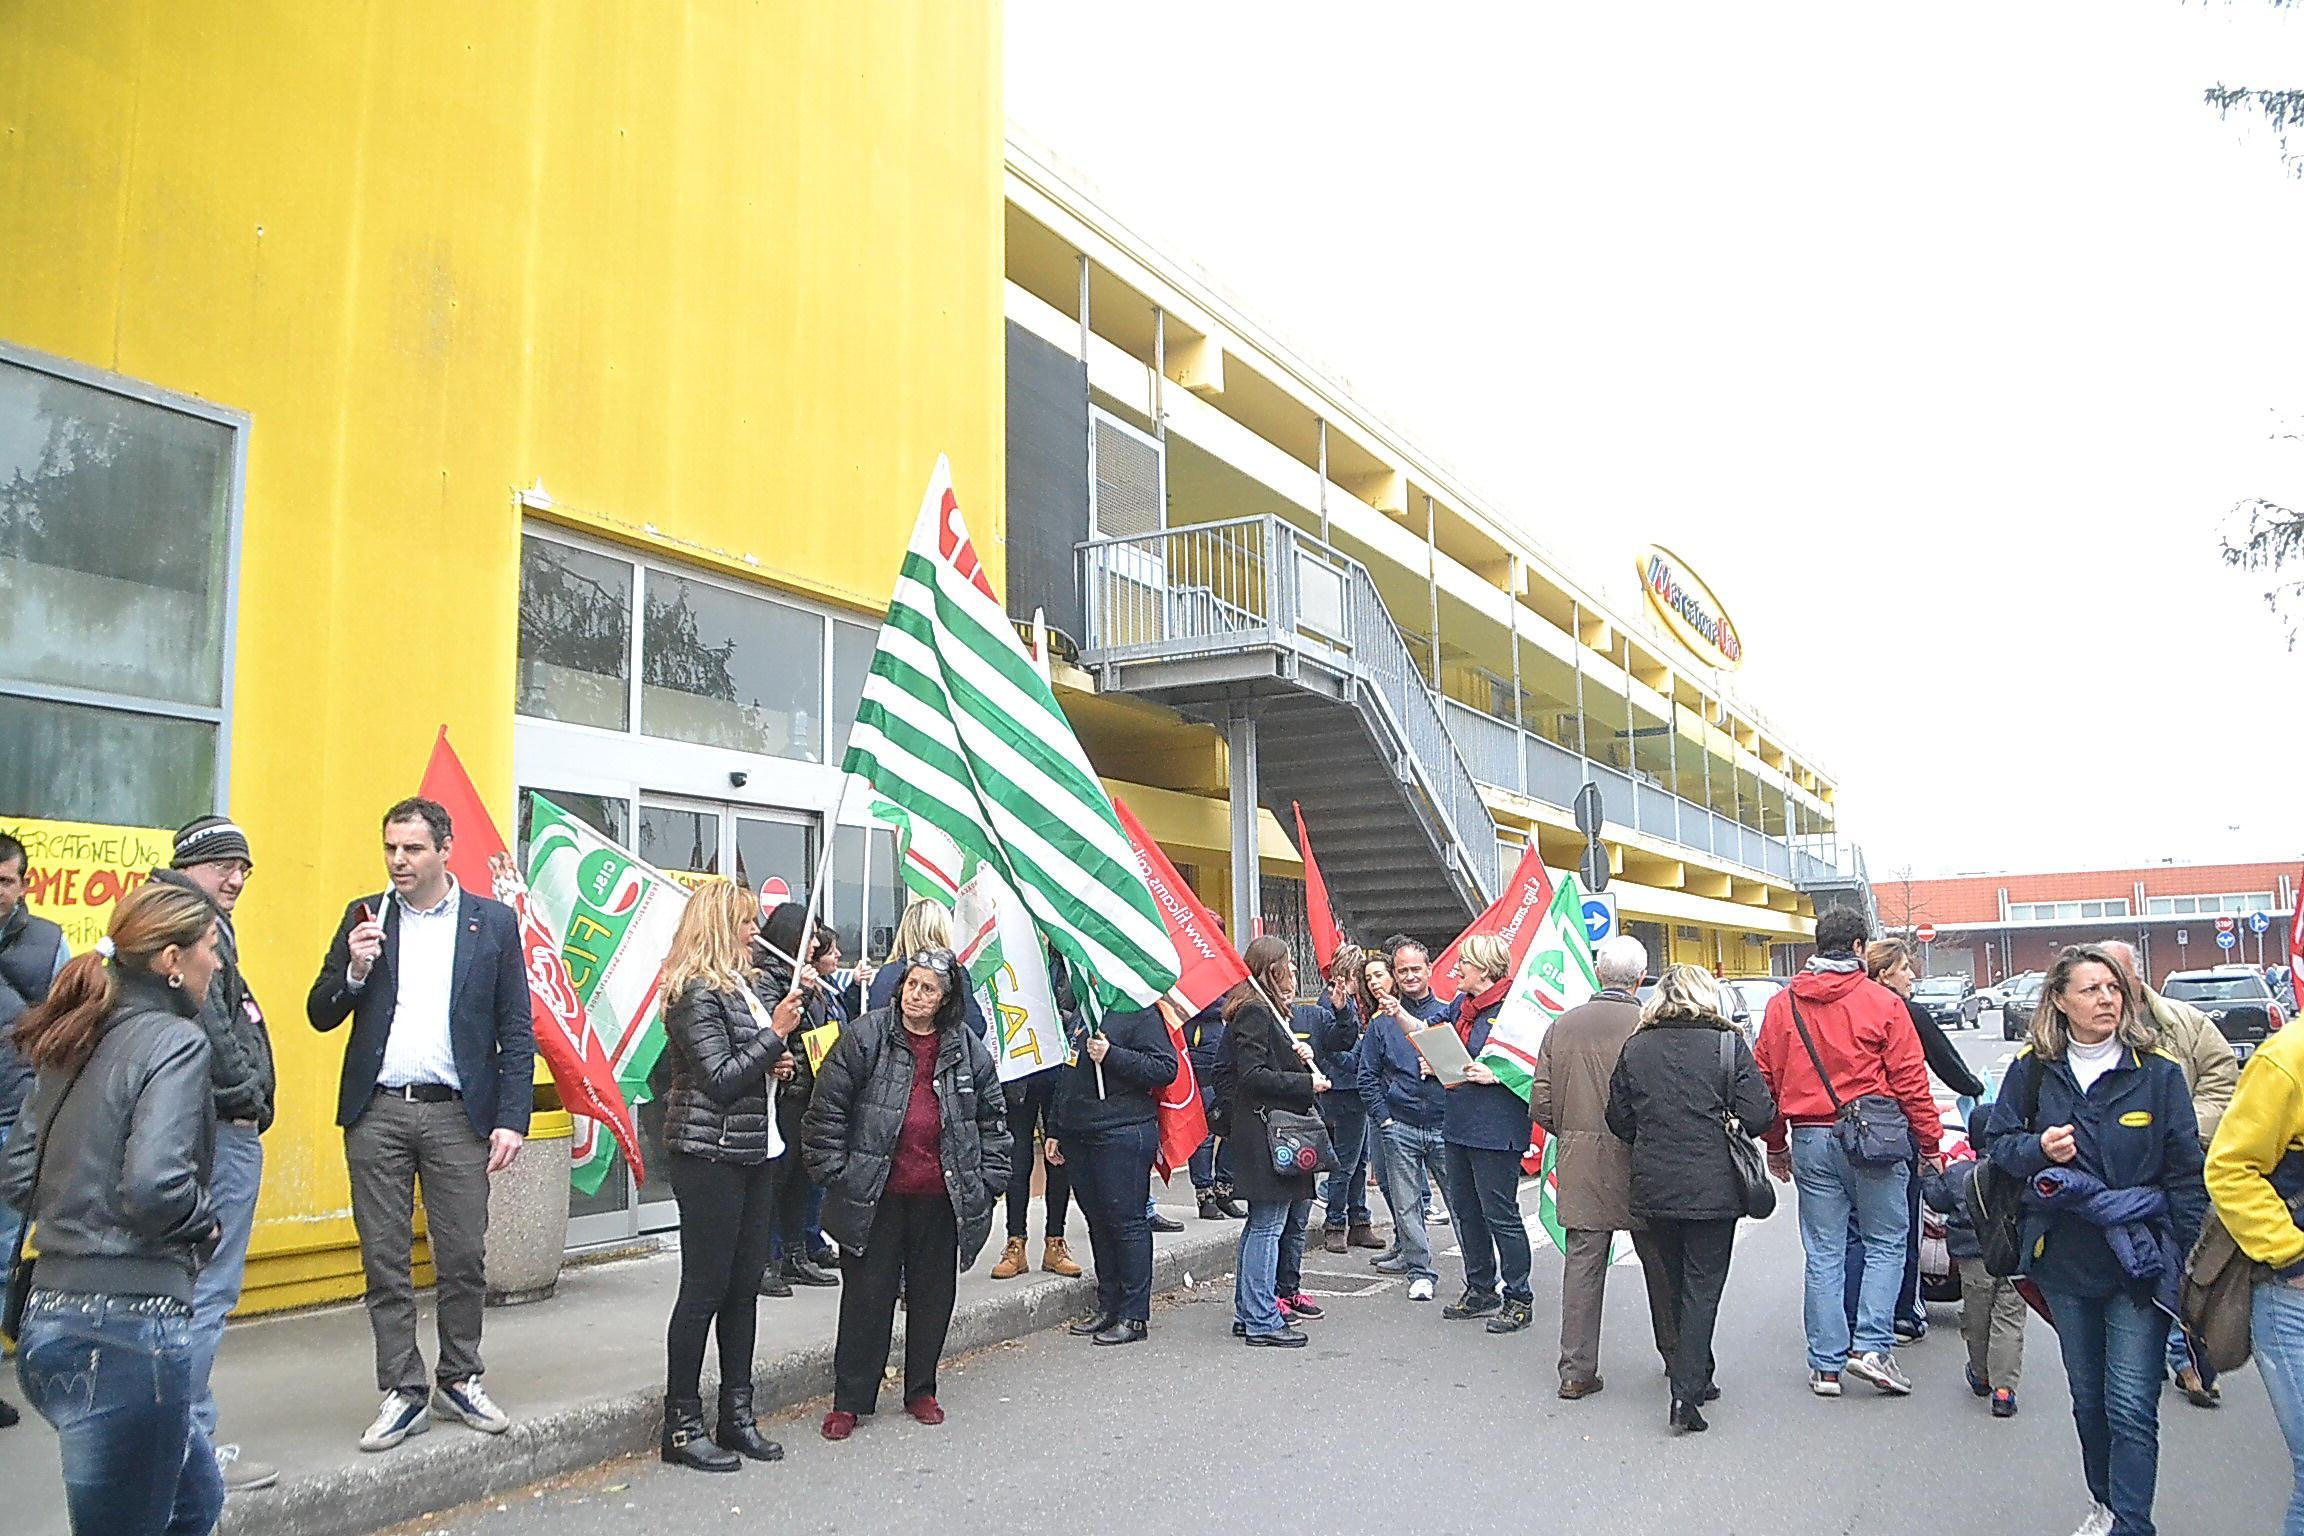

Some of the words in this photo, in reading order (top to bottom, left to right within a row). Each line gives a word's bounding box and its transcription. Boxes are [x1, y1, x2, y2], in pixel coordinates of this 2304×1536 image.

[23, 867, 80, 906] AME
[83, 869, 146, 907] OVE
[2215, 920, 2232, 928] STOP
